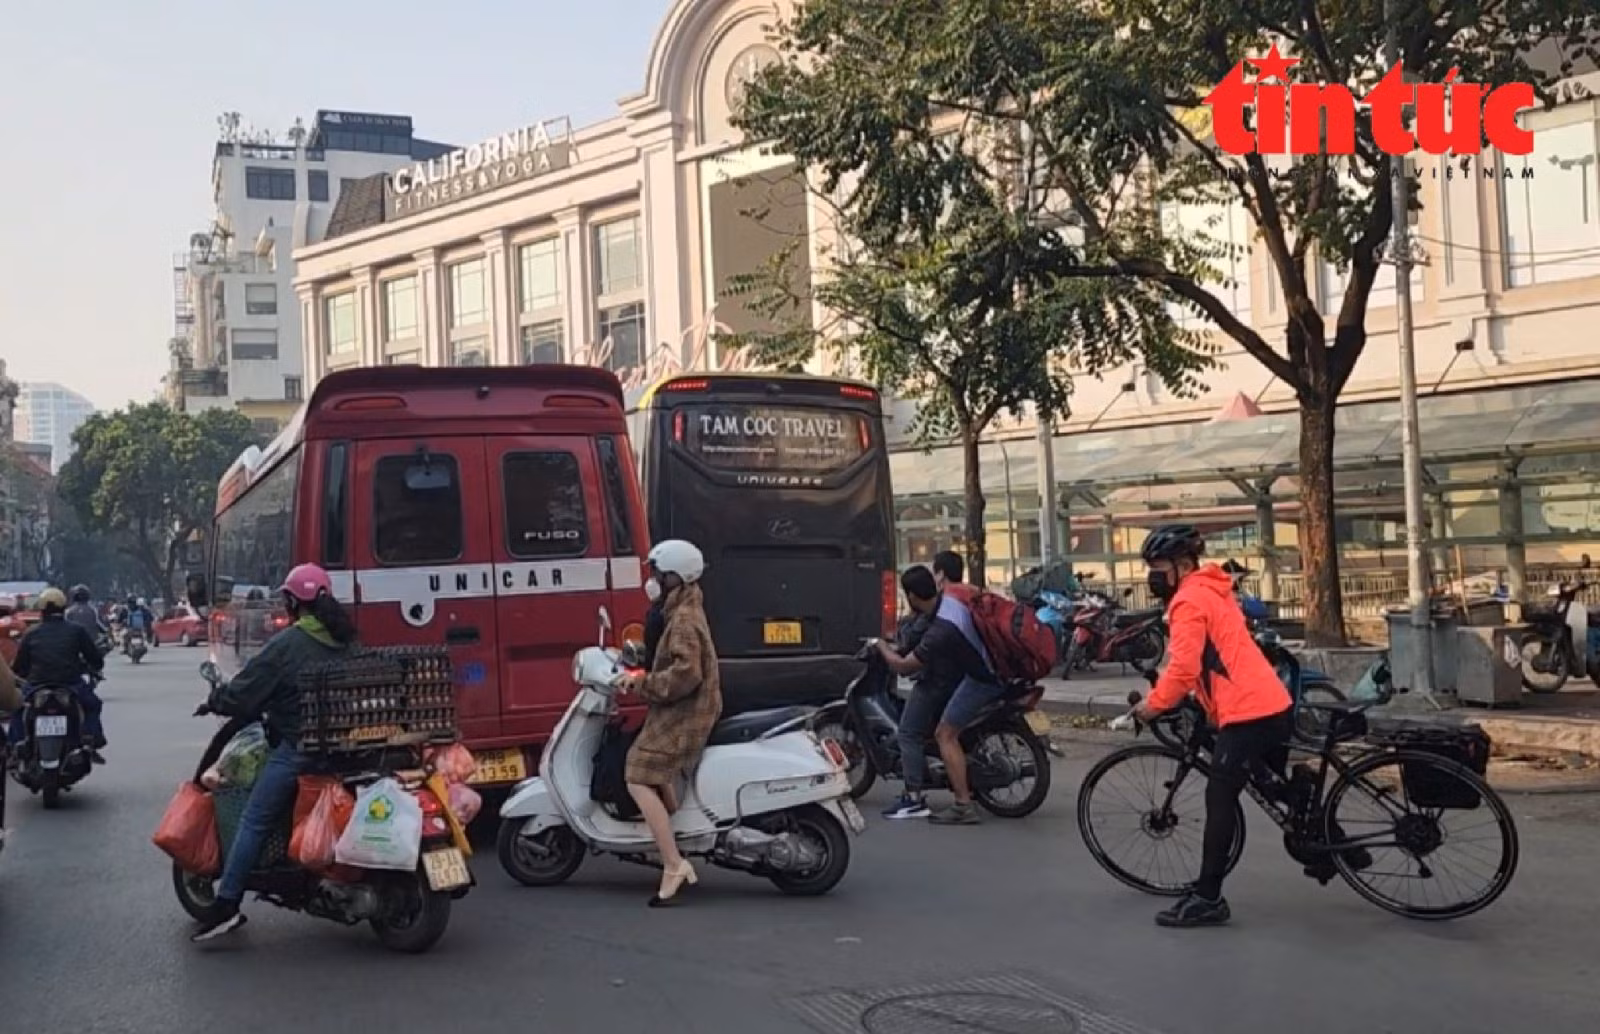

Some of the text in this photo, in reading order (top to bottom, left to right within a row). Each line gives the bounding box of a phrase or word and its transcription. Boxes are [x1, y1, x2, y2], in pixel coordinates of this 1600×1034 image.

[395, 121, 550, 195] CALIFORNIA
[701, 414, 739, 435] TAM
[784, 417, 846, 438] TRAVEL
[524, 530, 579, 540] FUSO
[429, 569, 562, 592] UNICAR
